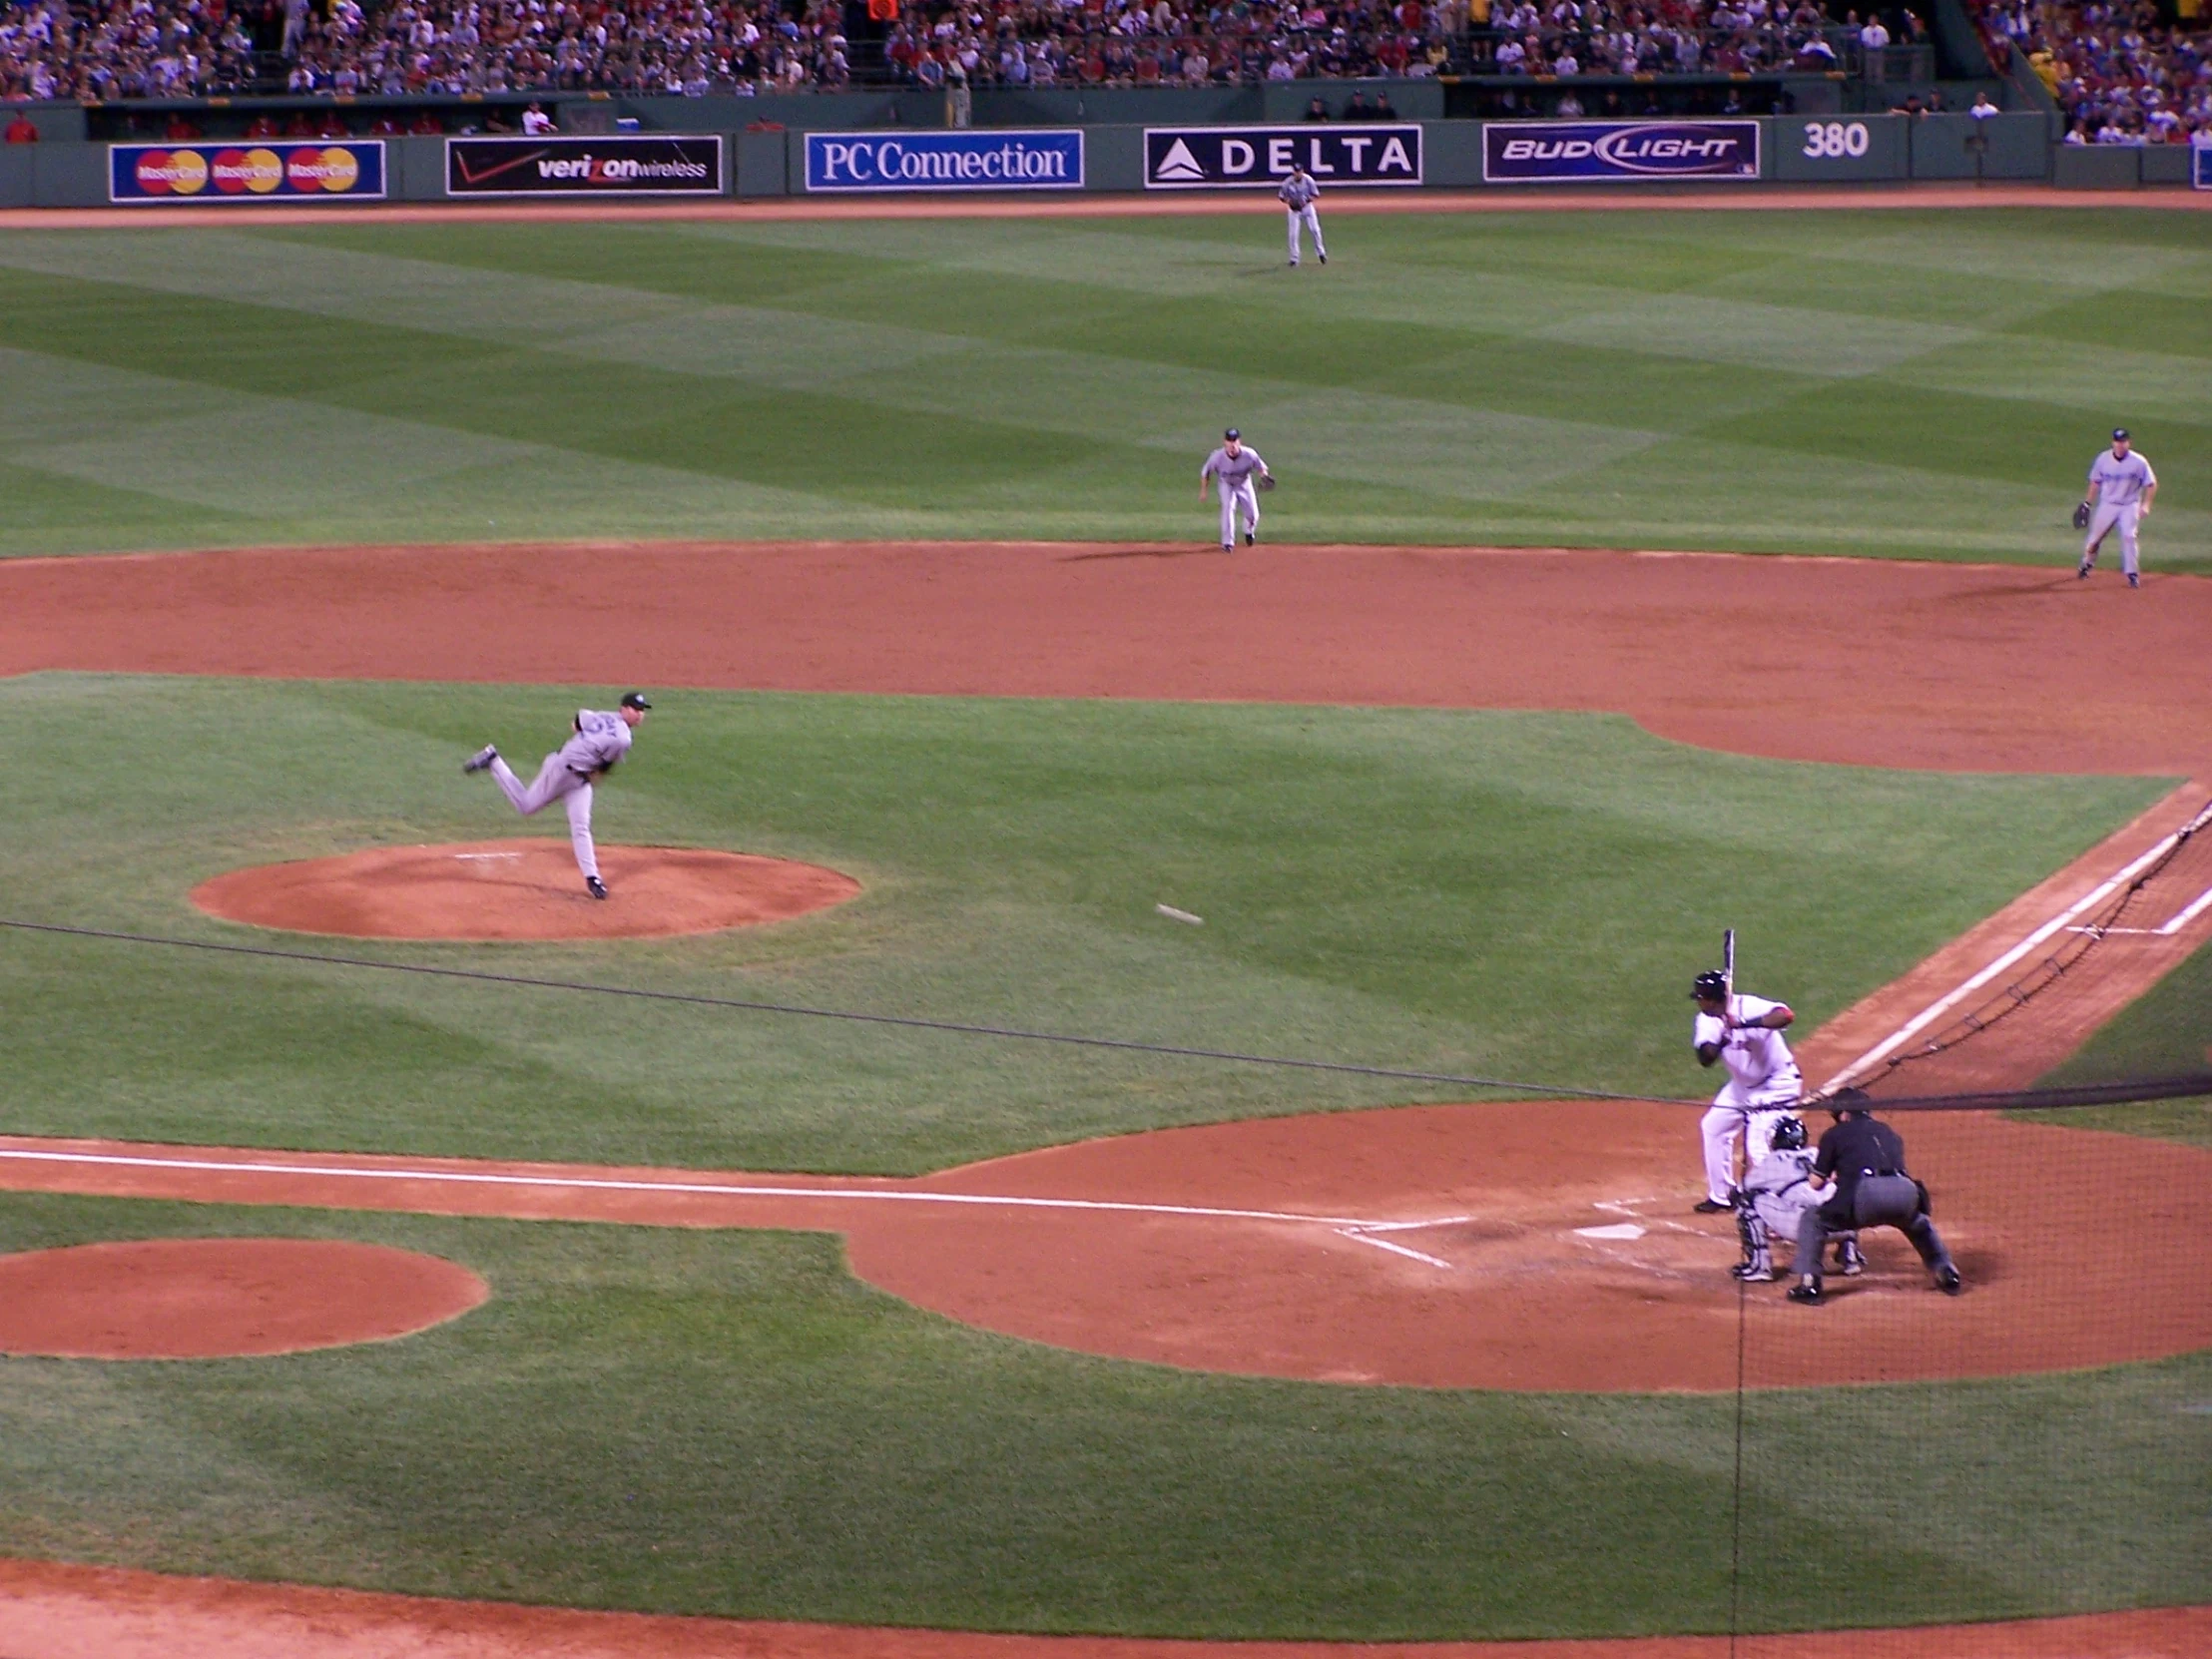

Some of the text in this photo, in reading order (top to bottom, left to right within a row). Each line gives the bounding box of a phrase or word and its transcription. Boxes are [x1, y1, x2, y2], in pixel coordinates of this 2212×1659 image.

[1221, 137, 1412, 175] DELTA
[1501, 139, 1738, 160] BUD LIGHT
[1803, 122, 1869, 158] 380
[823, 142, 1067, 181] PC Connection
